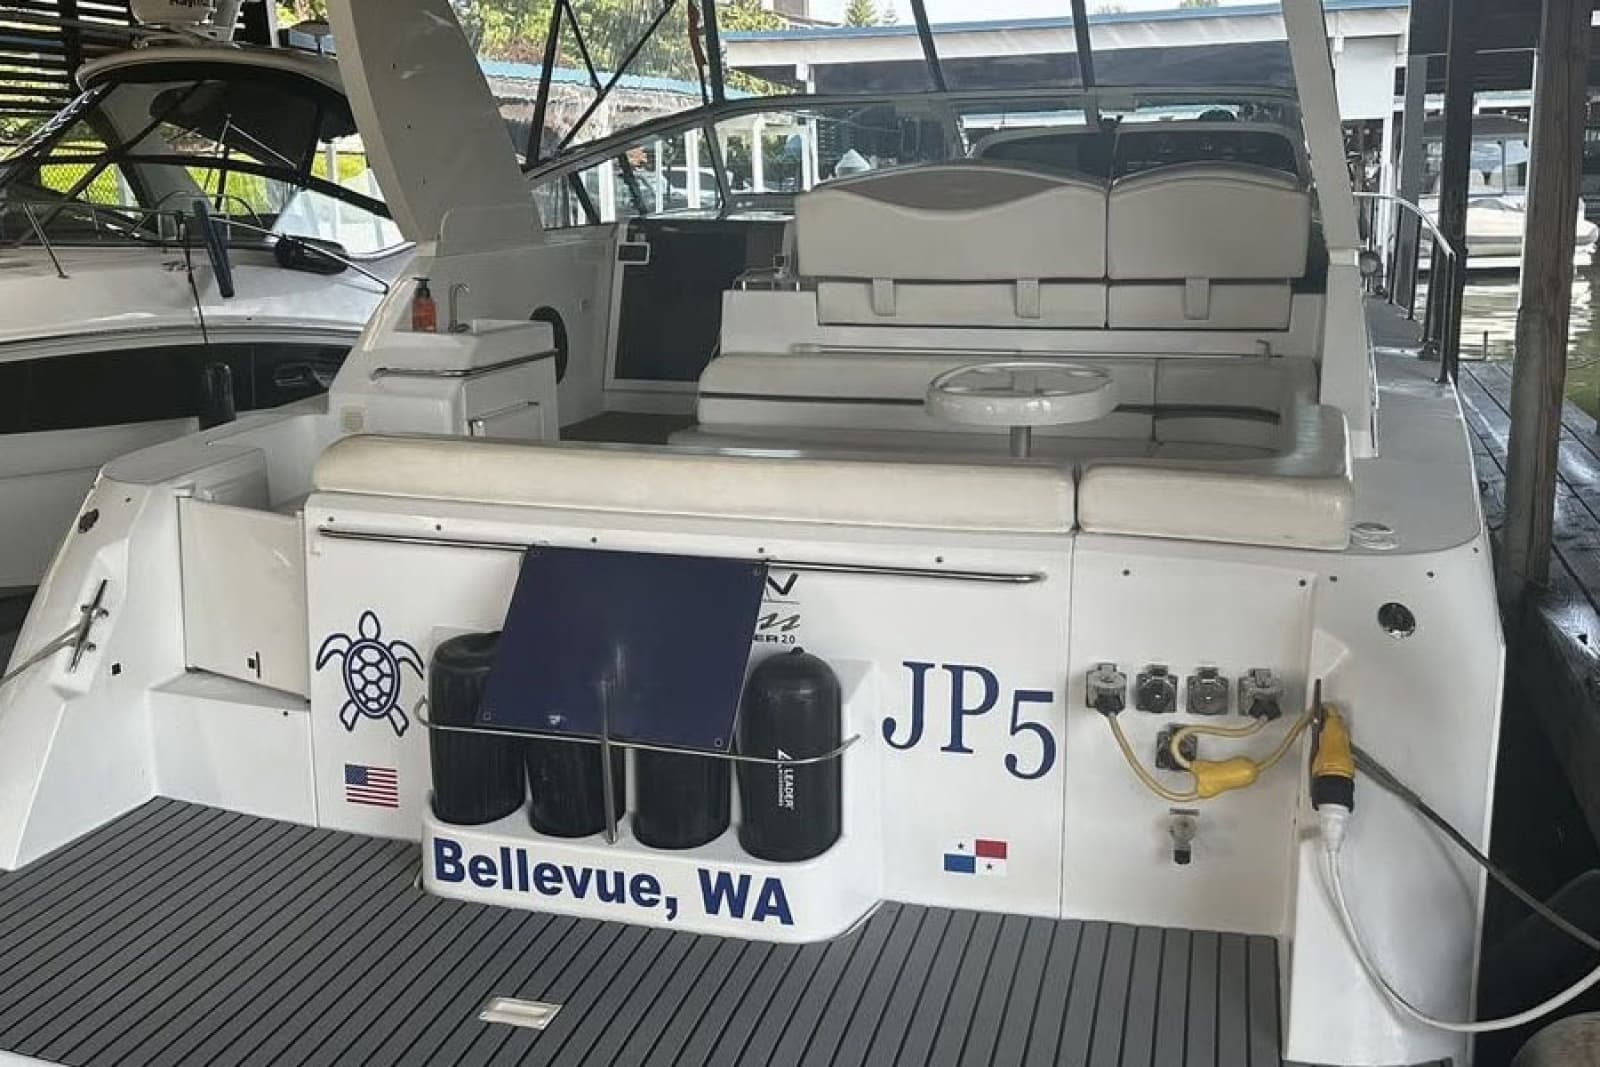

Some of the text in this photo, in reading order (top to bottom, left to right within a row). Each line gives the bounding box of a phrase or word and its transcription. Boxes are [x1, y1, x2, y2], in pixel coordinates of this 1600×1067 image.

[882, 661, 1057, 780] JP5
[783, 768, 794, 810] LEADER
[433, 838, 794, 926] Bellevue, WA
